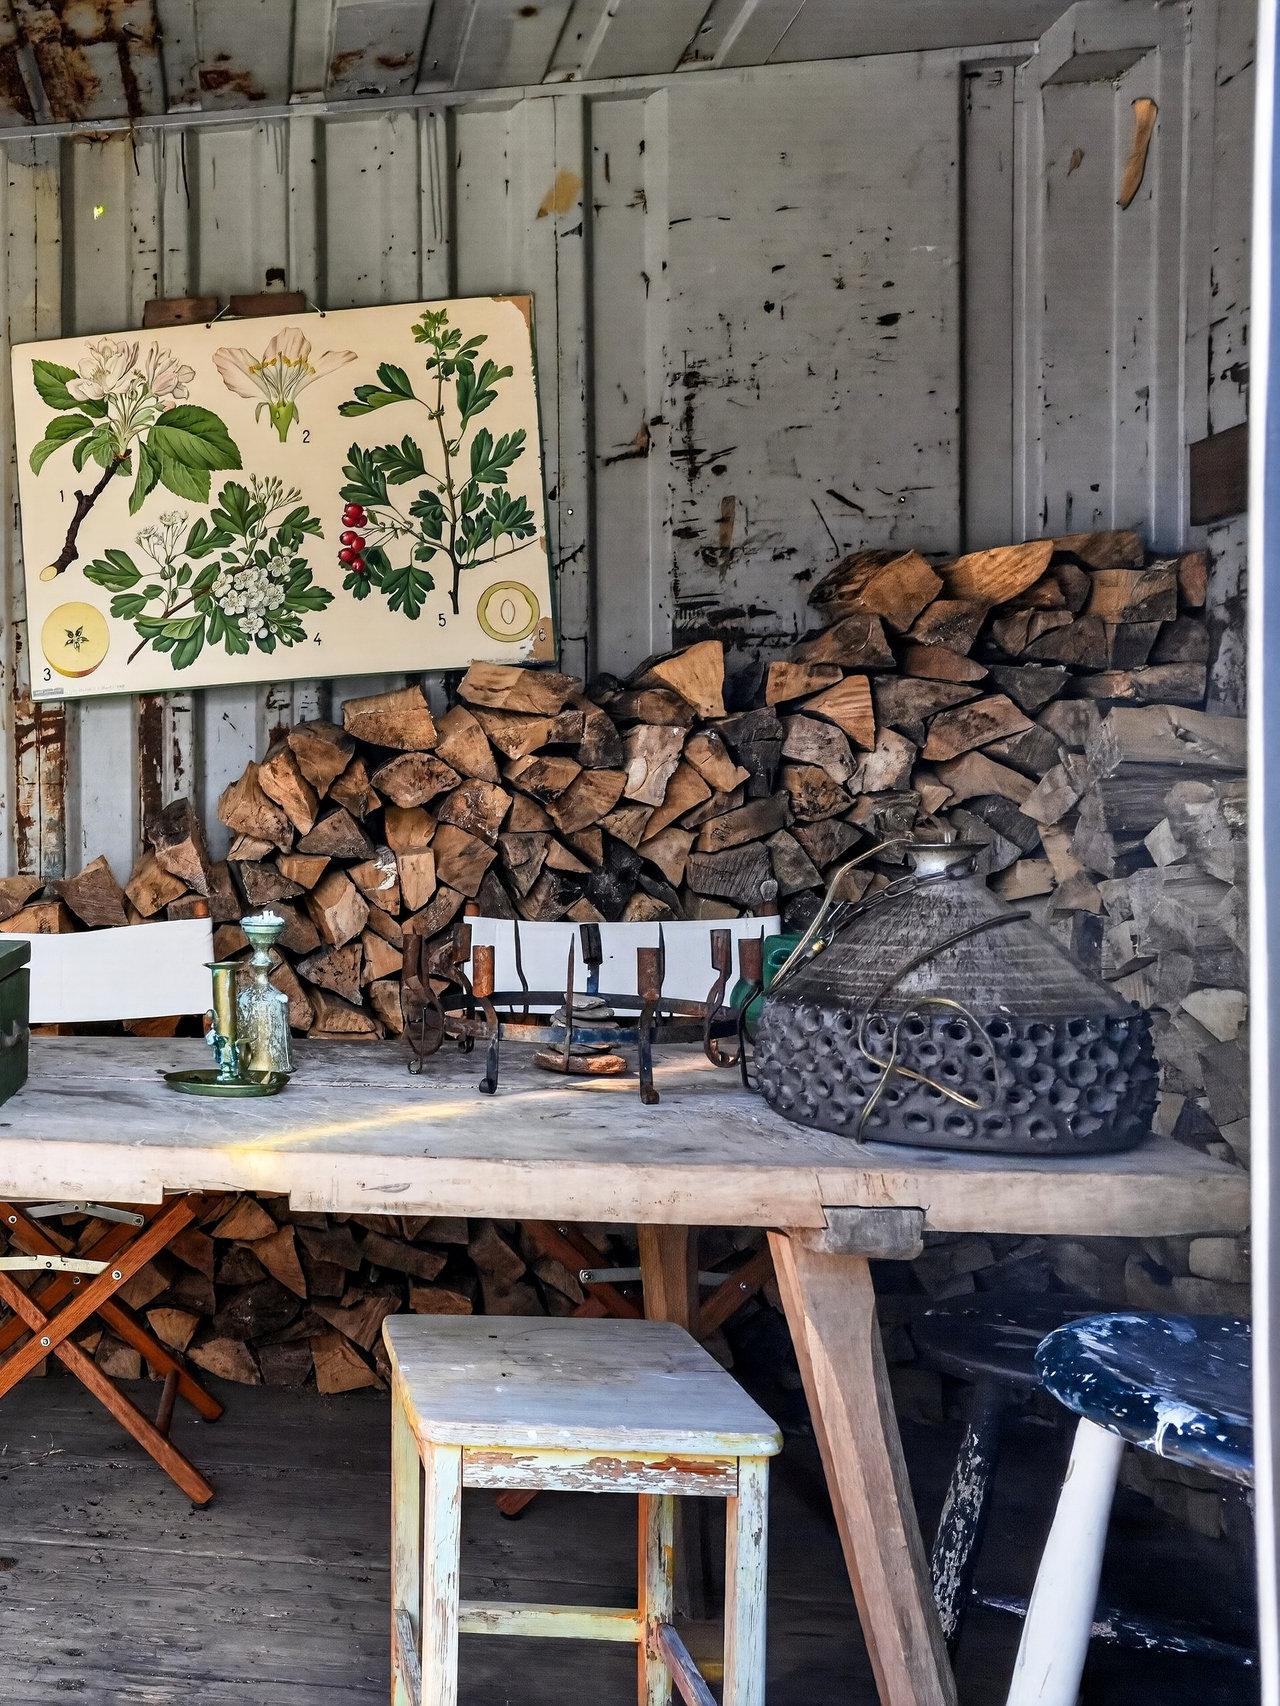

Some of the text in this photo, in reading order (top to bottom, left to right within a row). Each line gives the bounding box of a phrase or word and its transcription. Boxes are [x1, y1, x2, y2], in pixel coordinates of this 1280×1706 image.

[302, 429, 311, 443] 2
[59, 489, 64, 503] 1
[438, 613, 447, 627] 5
[313, 632, 322, 646] 4
[43, 667, 52, 681] 3
